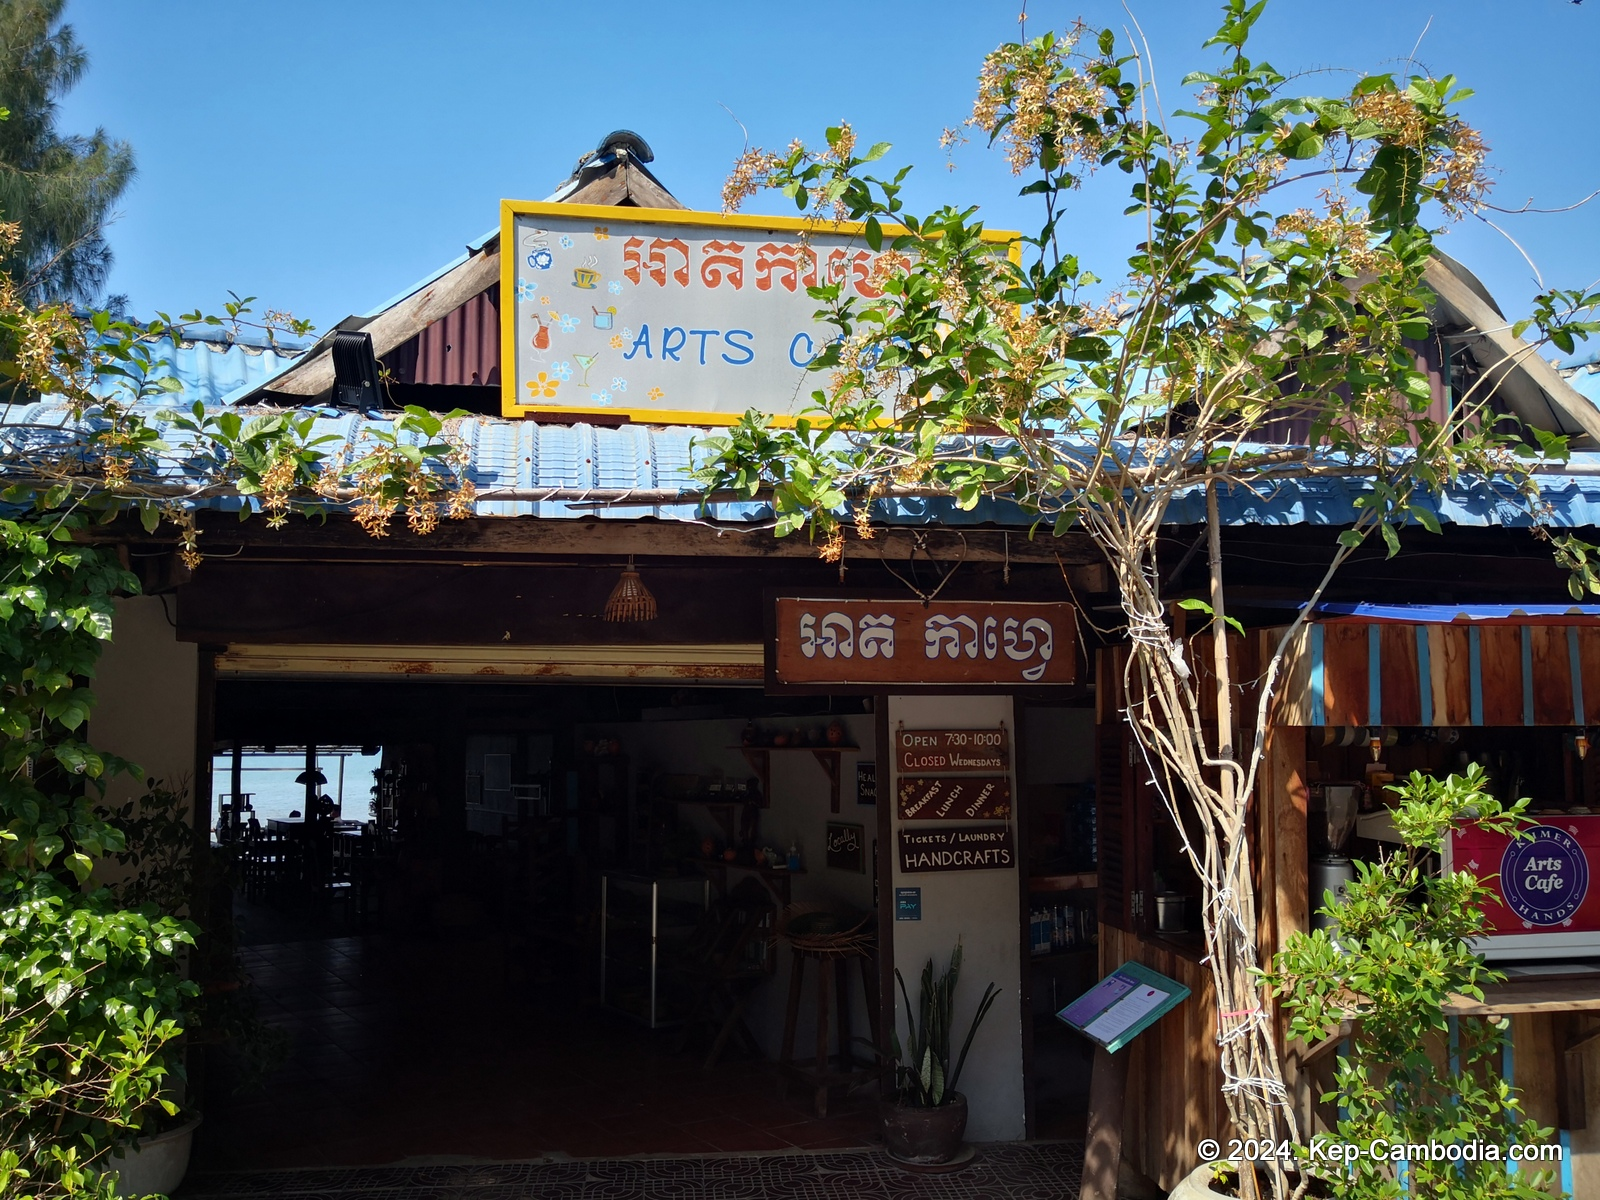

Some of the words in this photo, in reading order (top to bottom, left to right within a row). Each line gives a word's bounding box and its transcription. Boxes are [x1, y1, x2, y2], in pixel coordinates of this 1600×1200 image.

[623, 325, 755, 366] ARTS
[902, 733, 938, 747] OPEN
[904, 752, 946, 768] CLOSED
[948, 752, 1002, 767] WEDNESDAYS
[904, 780, 943, 818] BREAKFAST
[935, 784, 964, 818] LUNCH
[965, 783, 996, 818] DINNER
[827, 828, 860, 853] Locally
[903, 834, 947, 845] TICKETS
[958, 832, 1005, 843] LAUNDRY
[904, 849, 1011, 869] HANDCRAFTS
[1523, 857, 1563, 872] Arts
[1524, 873, 1564, 893] Cafe
[1518, 902, 1575, 921] HANDS
